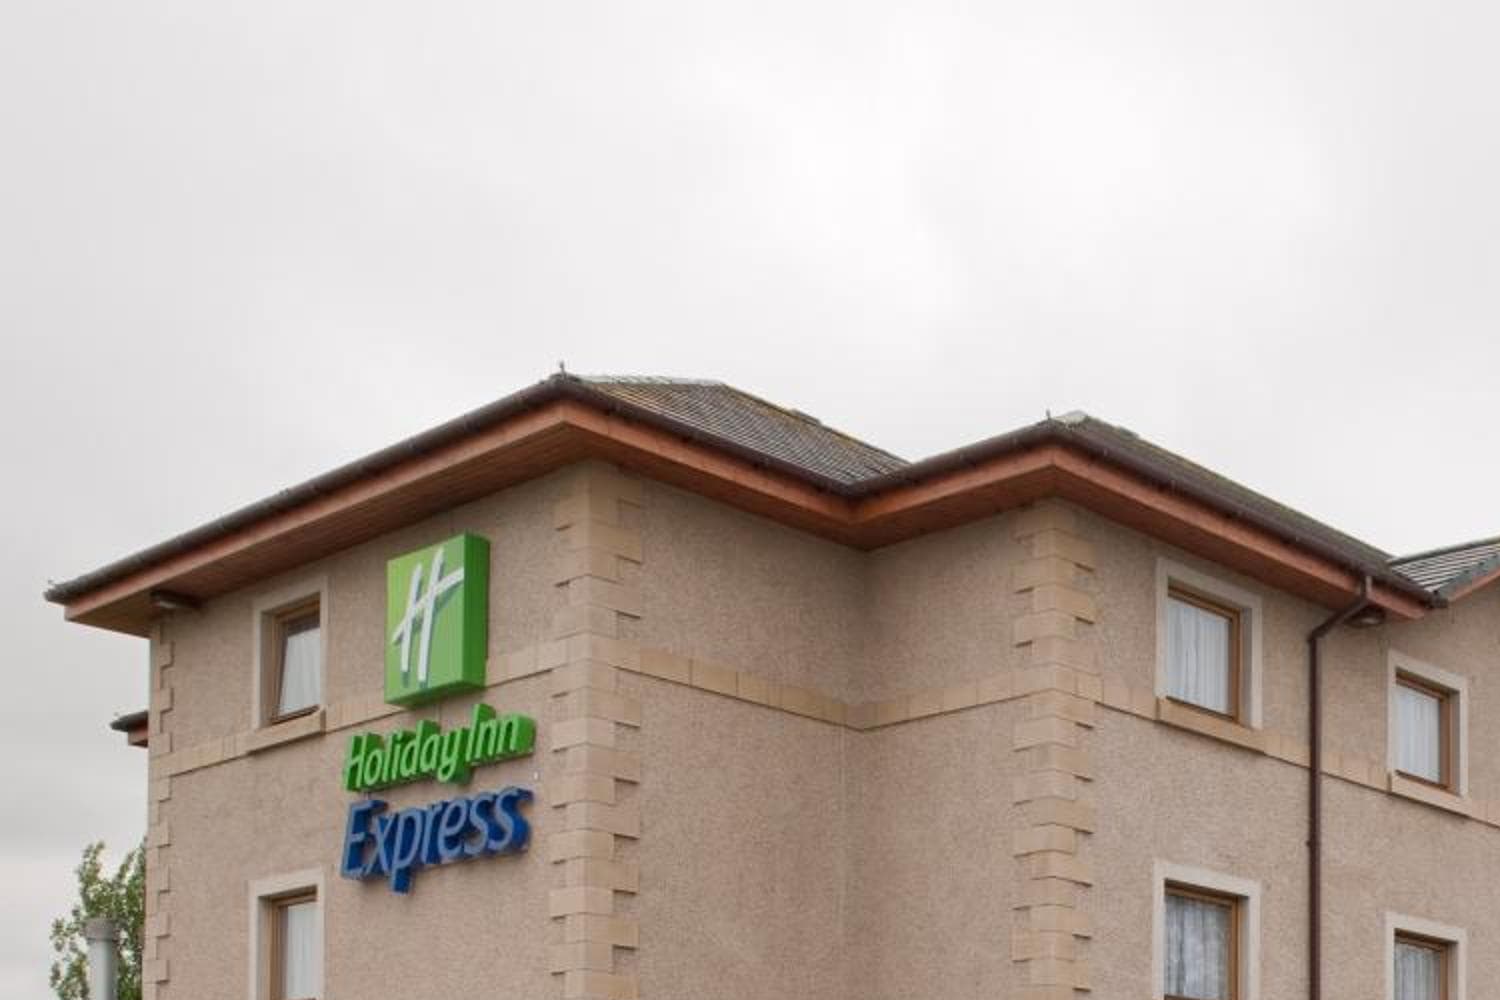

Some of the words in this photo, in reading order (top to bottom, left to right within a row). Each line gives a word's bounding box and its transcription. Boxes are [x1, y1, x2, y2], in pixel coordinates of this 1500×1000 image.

[344, 718, 471, 790] Holiday
[464, 703, 533, 764] Inn
[341, 786, 531, 893] Express
